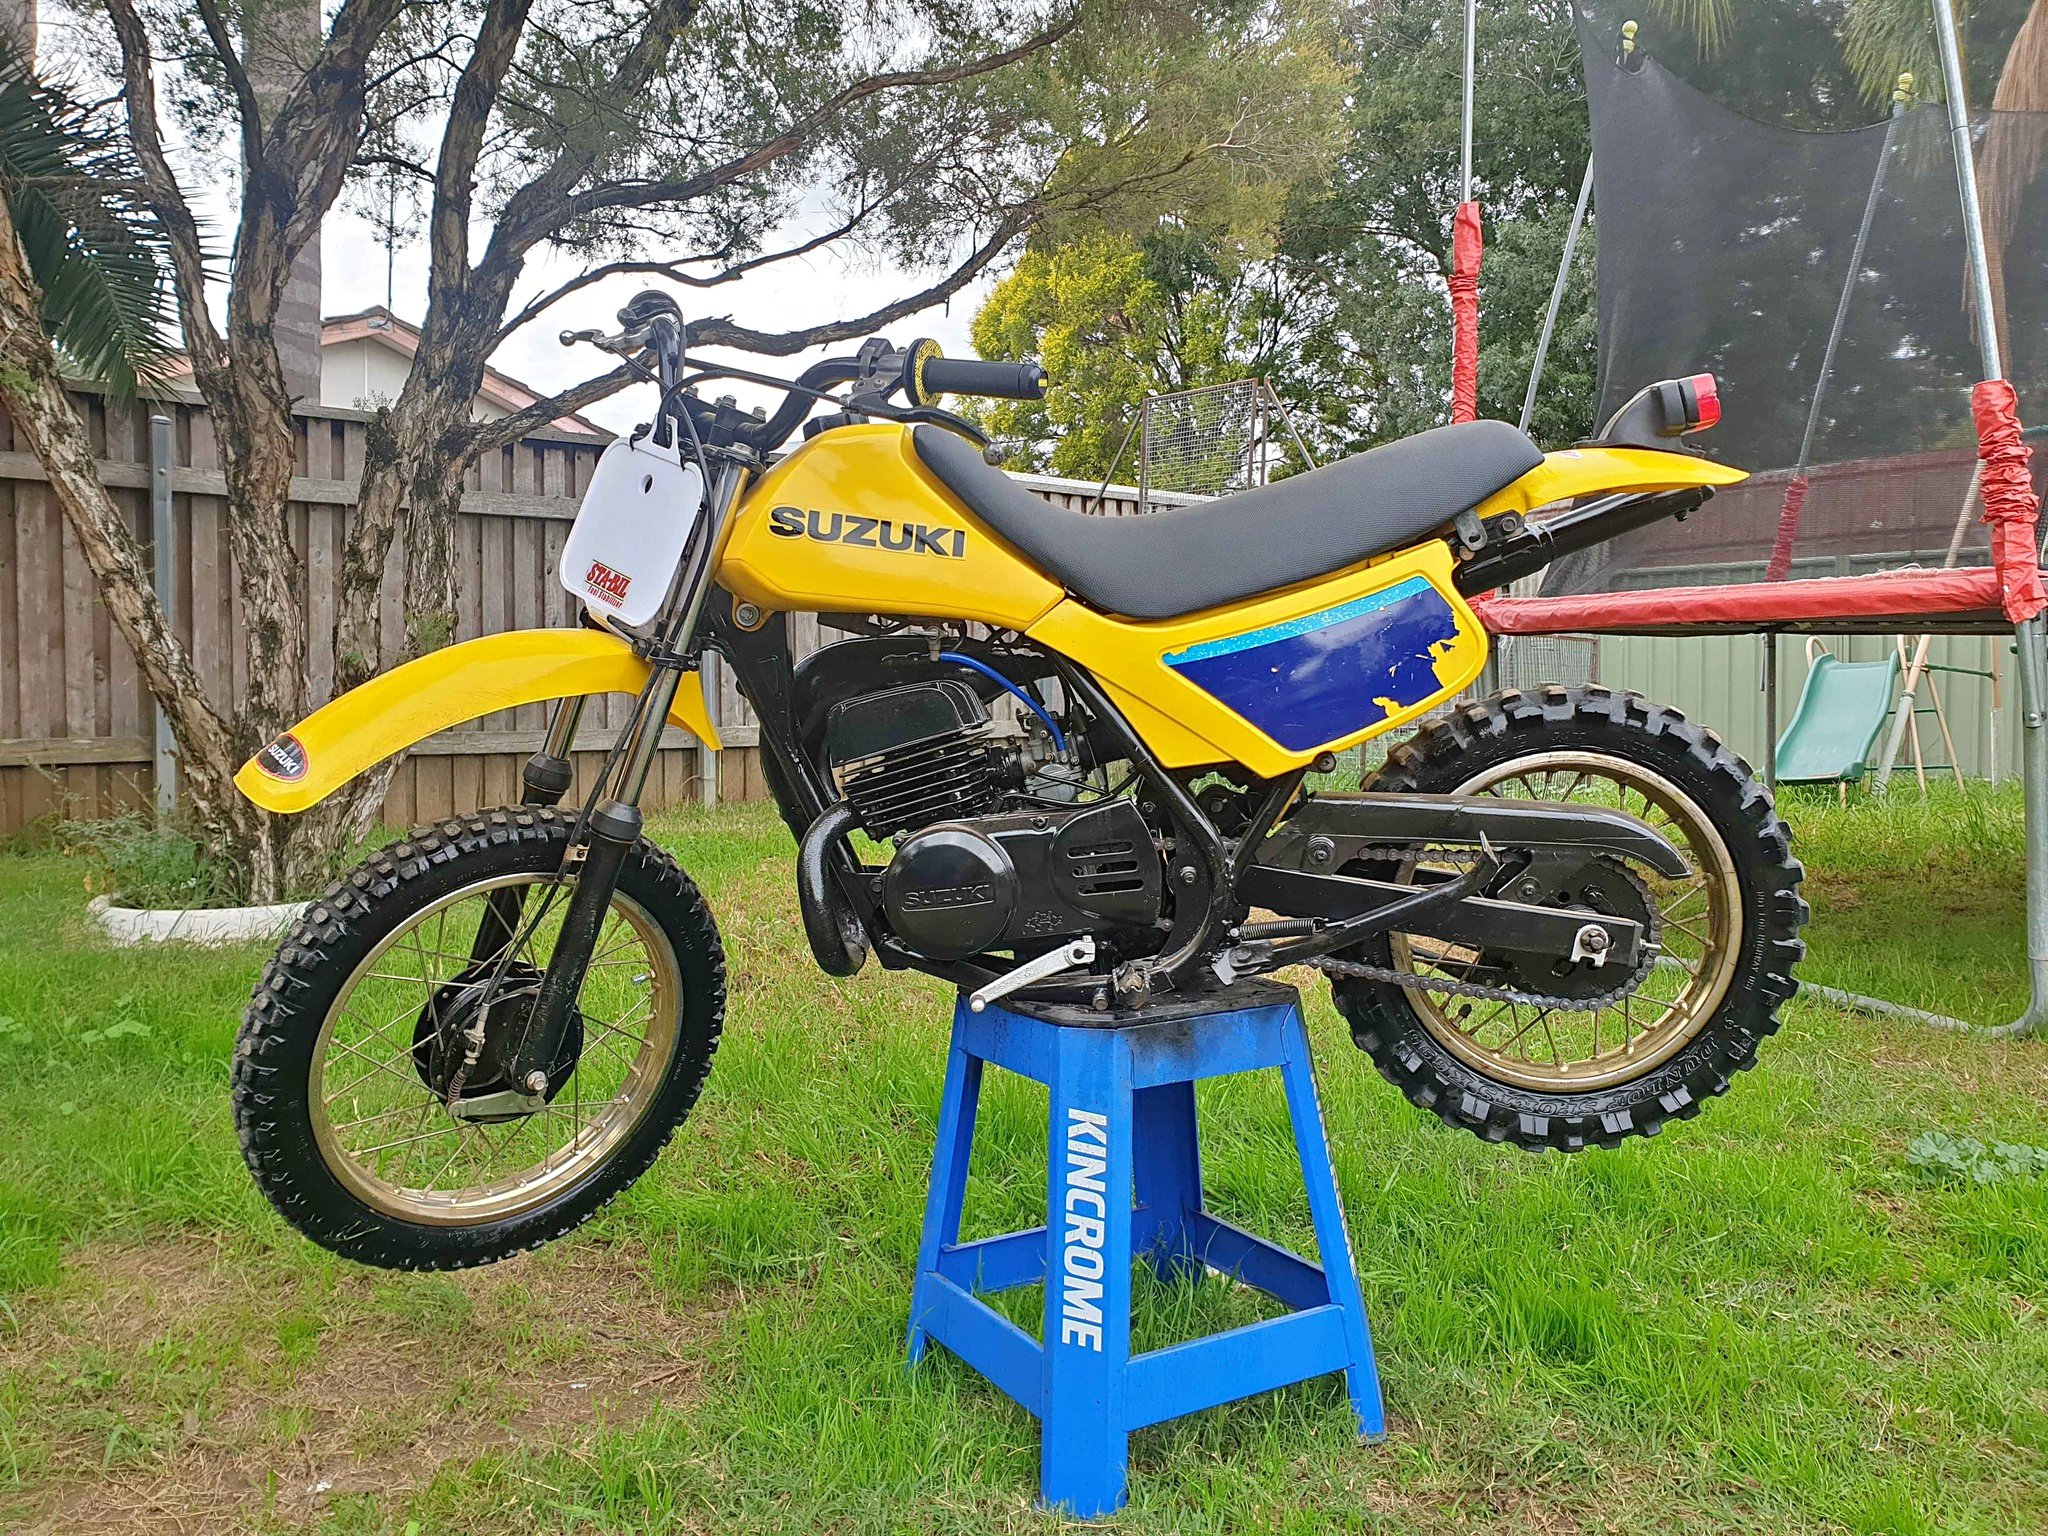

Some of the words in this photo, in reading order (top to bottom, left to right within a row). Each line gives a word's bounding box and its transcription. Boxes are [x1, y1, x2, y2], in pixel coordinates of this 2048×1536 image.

[769, 506, 966, 558] SUZUKI
[267, 744, 300, 774] SUZUKI
[904, 885, 990, 906] SUZUKI
[1607, 1035, 1719, 1112] DUNLOP
[1478, 1085, 1598, 1117] SPORTS
[1062, 1107, 1107, 1352] KINCROME
